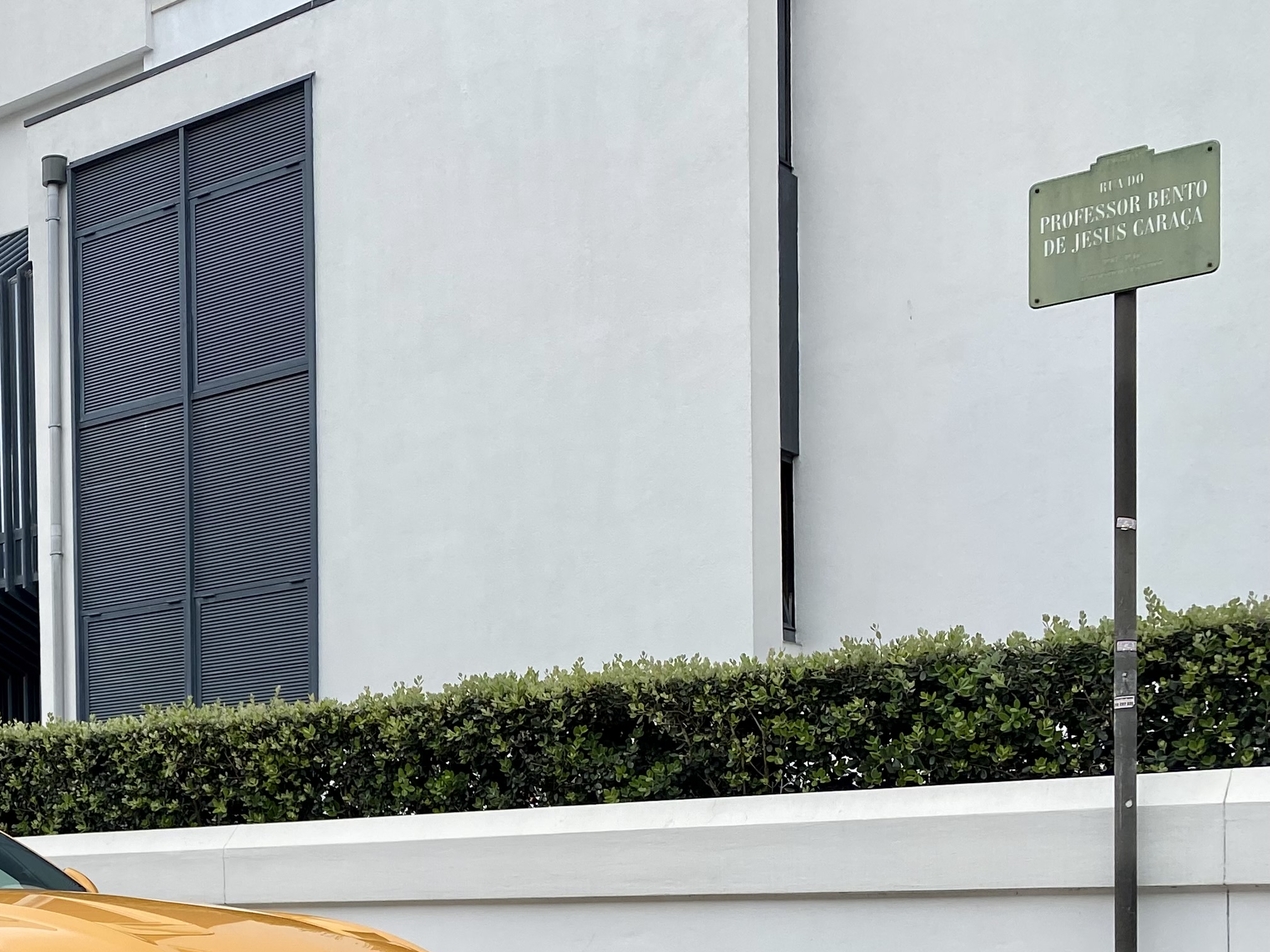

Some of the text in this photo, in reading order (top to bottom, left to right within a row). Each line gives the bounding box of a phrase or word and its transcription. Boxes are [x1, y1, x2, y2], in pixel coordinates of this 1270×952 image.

[1039, 179, 1208, 234] PROFESSOR BENTO
[1099, 172, 1144, 194] RUA DO
[1043, 205, 1203, 257] DE JESUS CARAÇA
